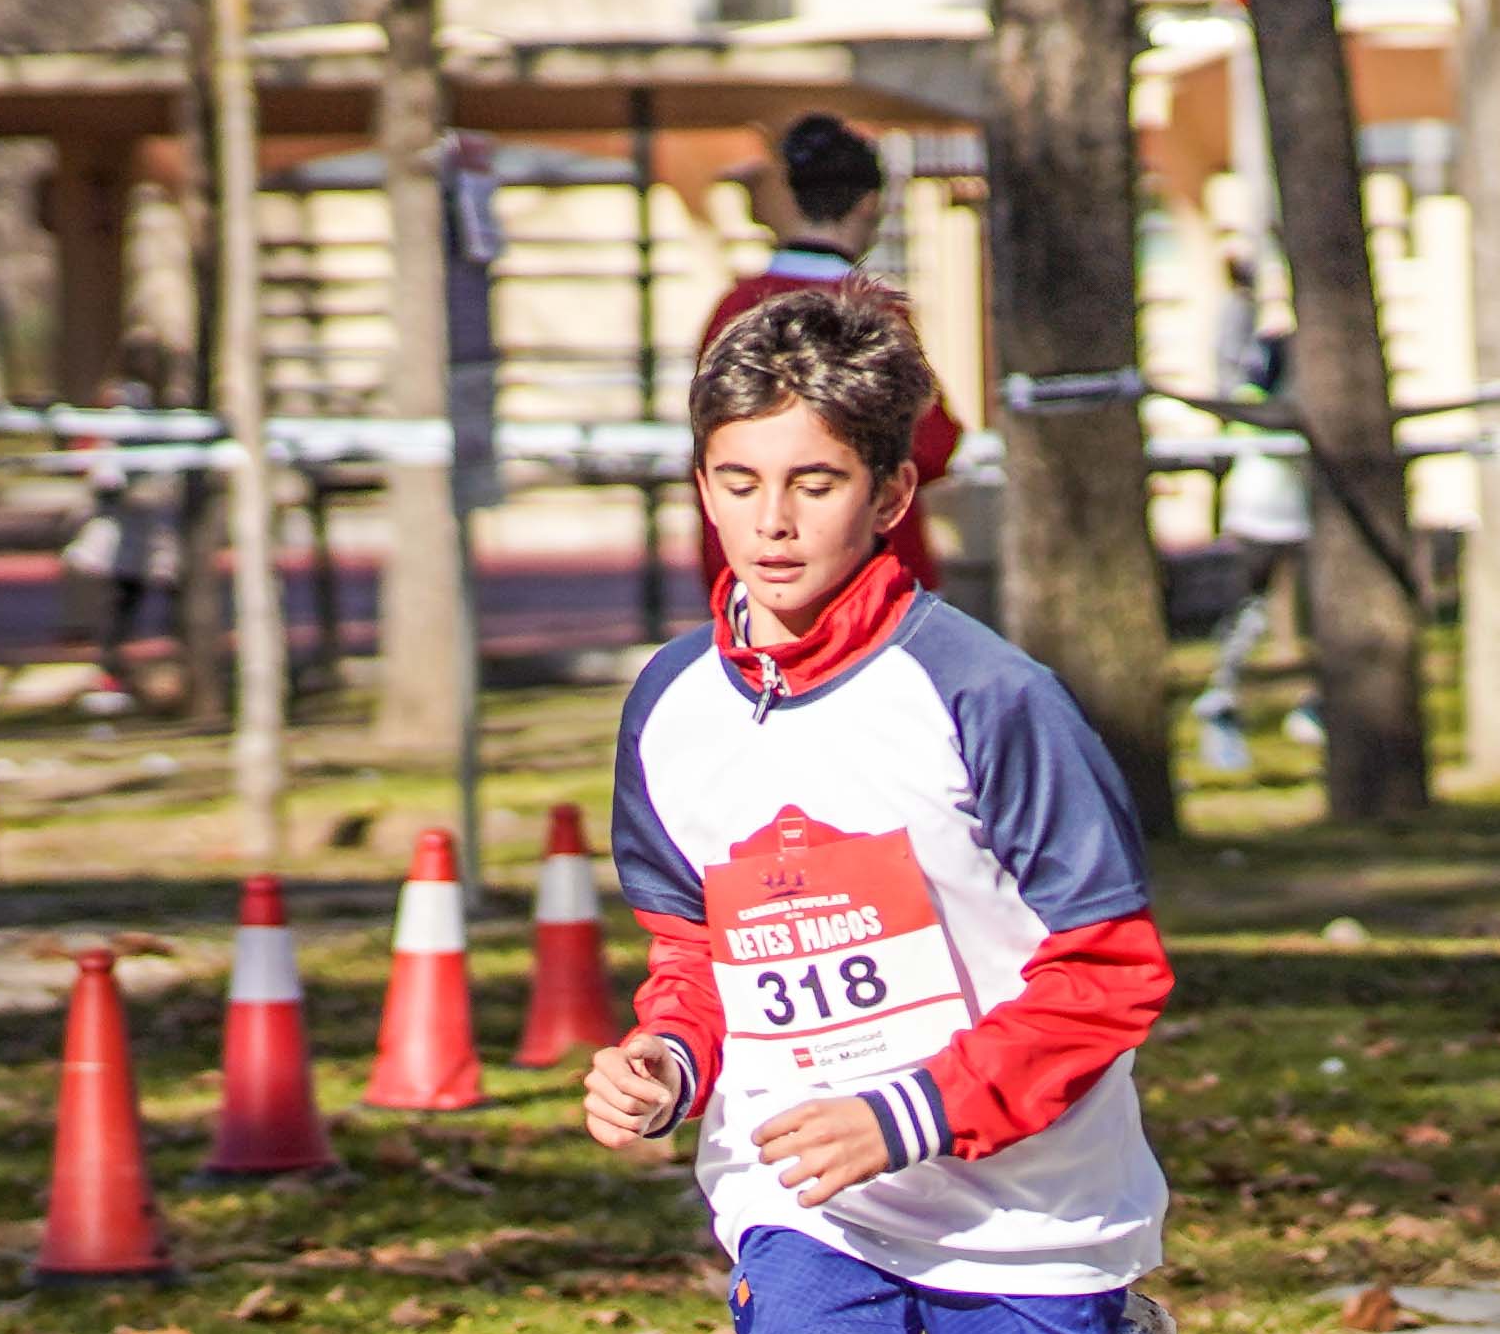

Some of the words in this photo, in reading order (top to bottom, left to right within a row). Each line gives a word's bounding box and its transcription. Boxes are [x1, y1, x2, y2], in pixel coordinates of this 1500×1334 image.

[725, 923, 794, 960] REYES
[795, 906, 883, 953] MAGOS
[757, 955, 887, 1026] 318
